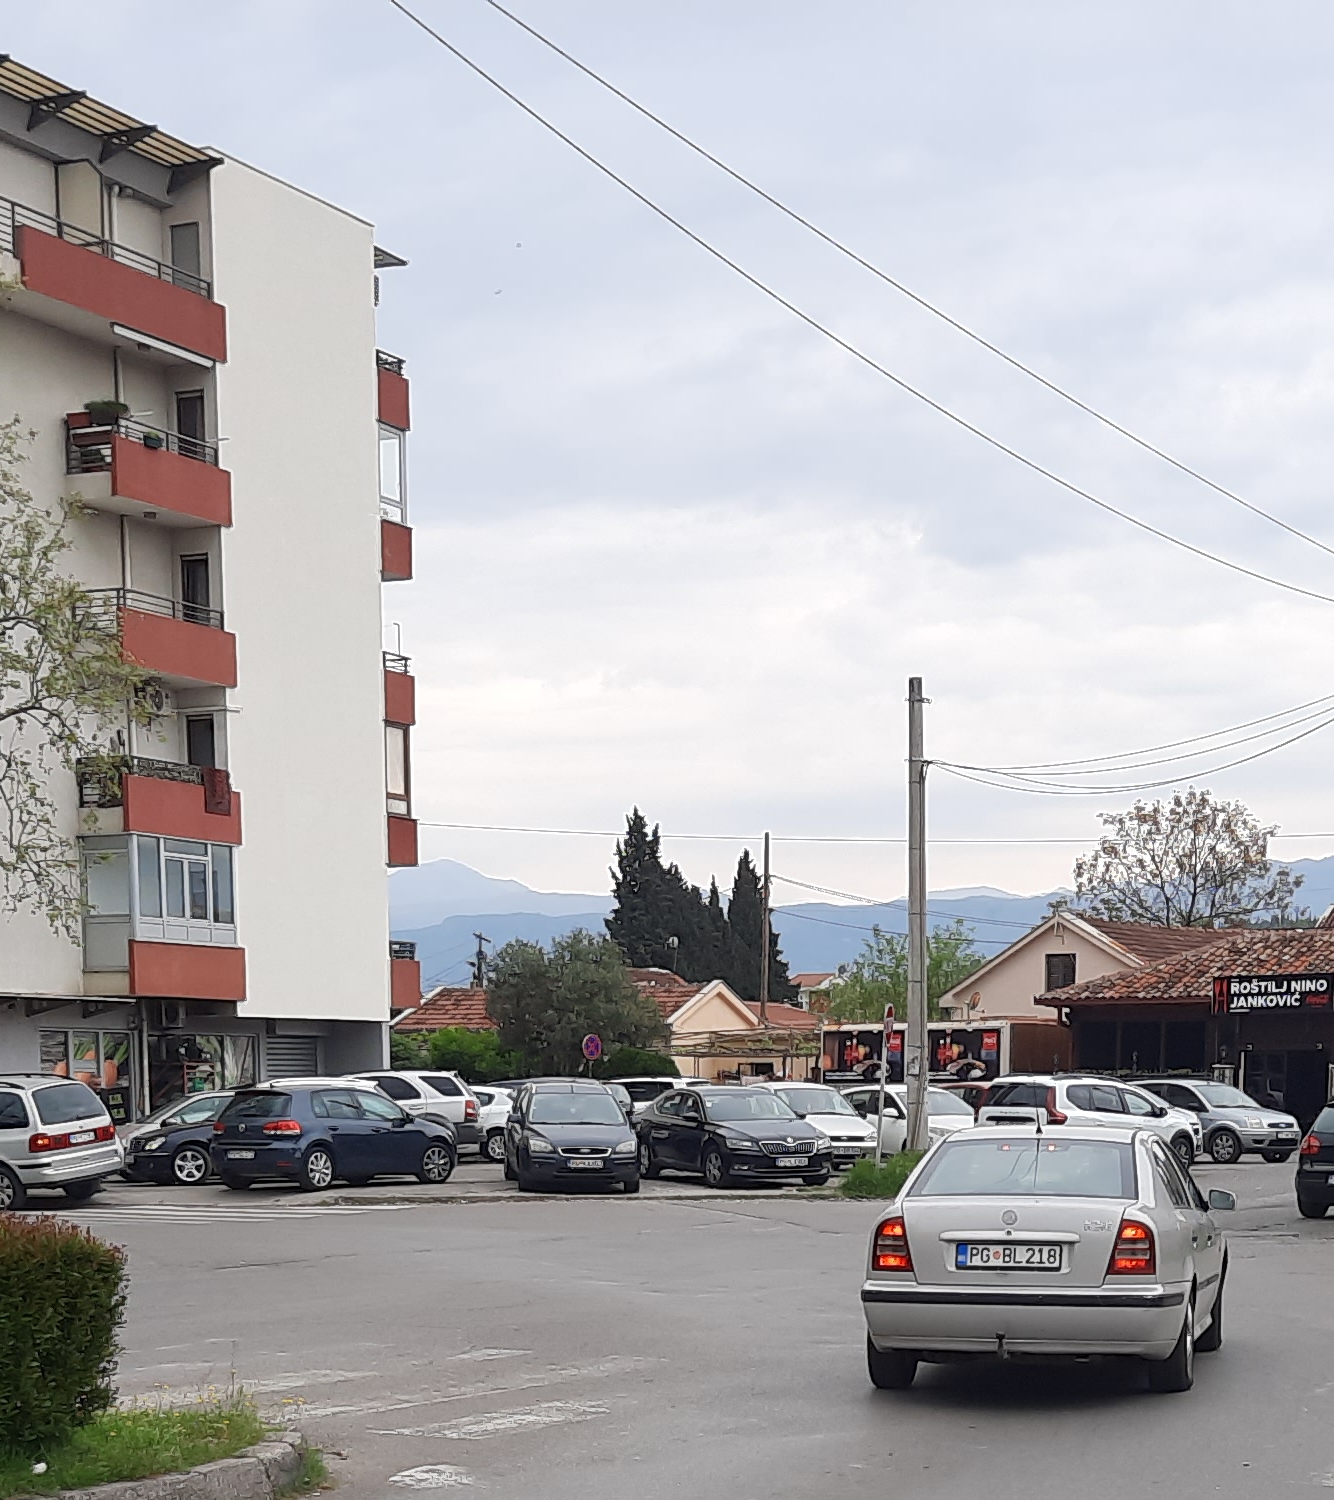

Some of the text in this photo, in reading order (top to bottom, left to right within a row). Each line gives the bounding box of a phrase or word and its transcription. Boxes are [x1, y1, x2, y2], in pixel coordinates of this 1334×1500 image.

[1230, 978, 1328, 995] ROŠTILJ NINO
[1229, 992, 1301, 1008] JANKOVIĆ
